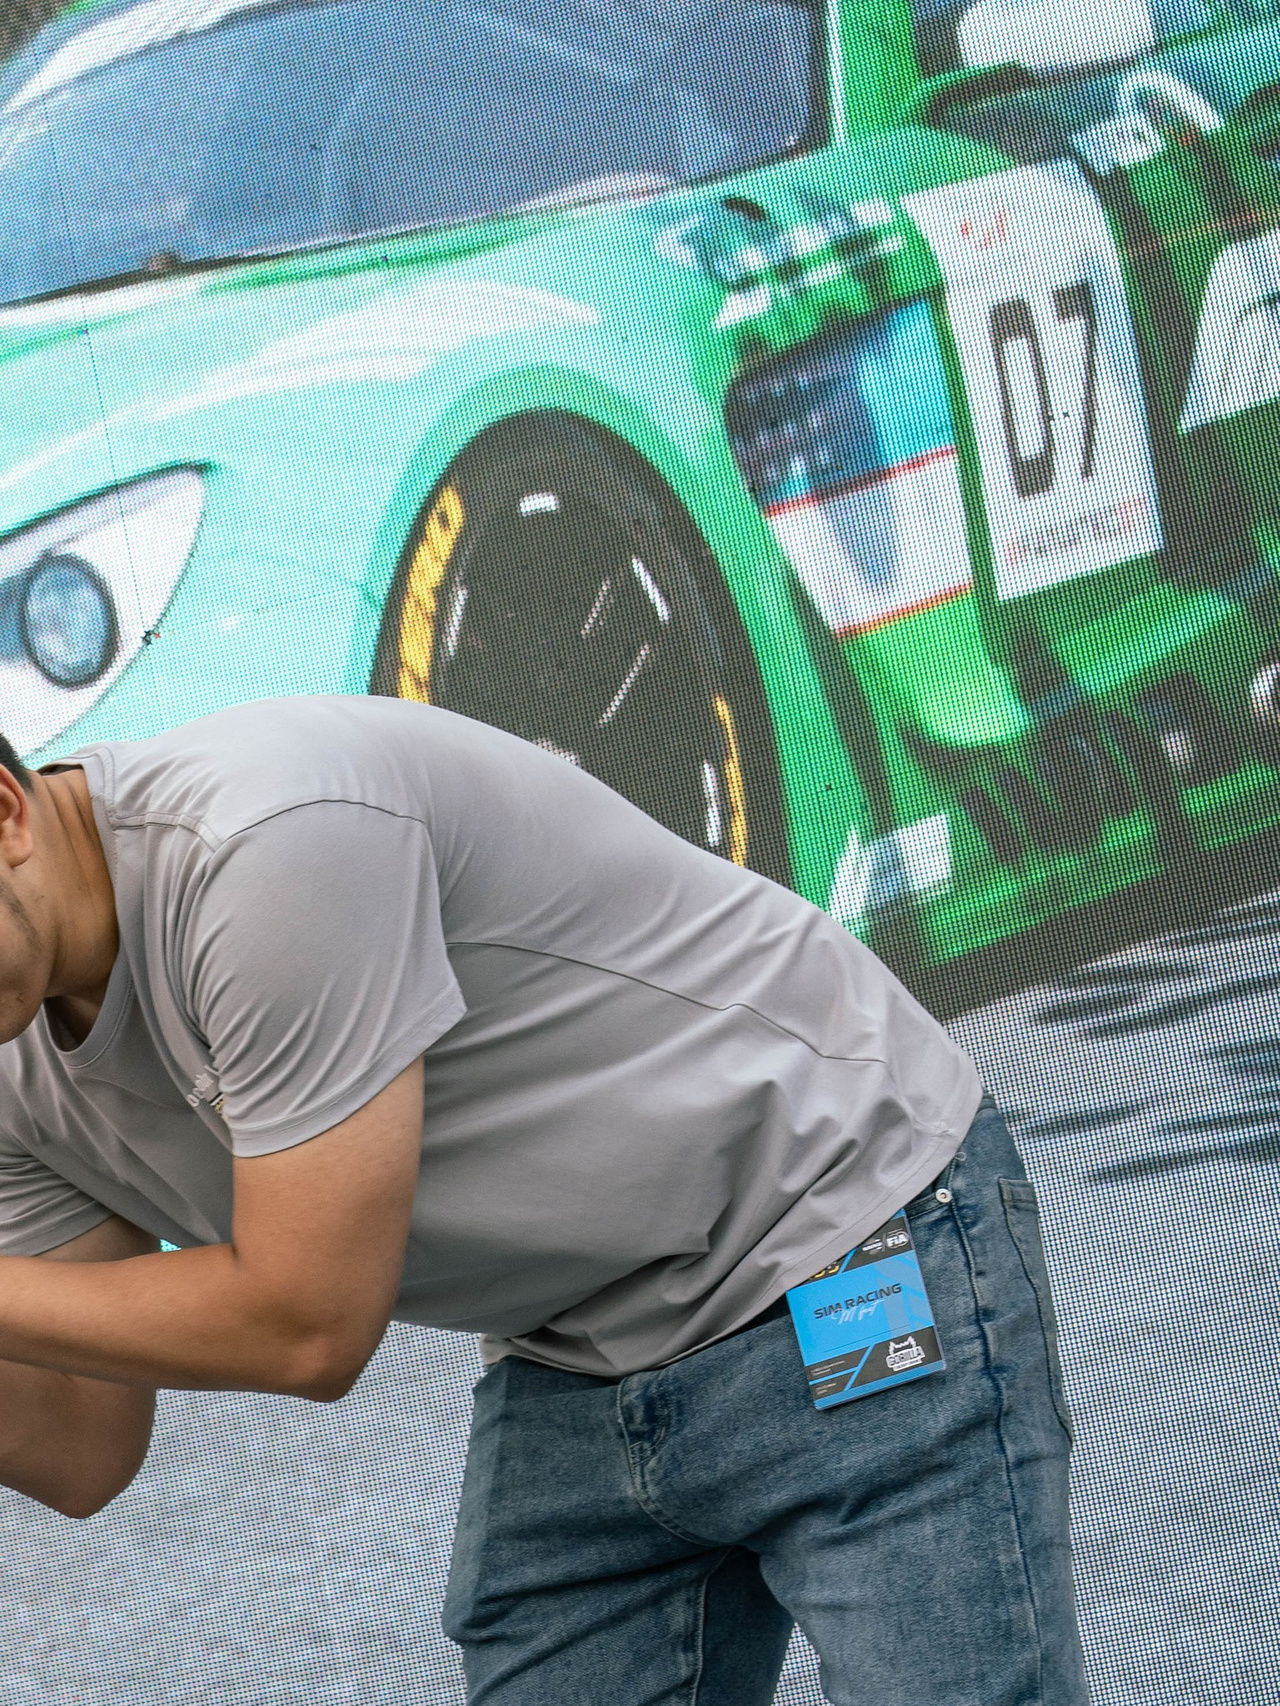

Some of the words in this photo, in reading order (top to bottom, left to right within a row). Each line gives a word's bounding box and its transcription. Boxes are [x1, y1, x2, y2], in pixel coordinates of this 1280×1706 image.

[988, 281, 1096, 498] 07
[814, 1302, 842, 1319] SIM
[845, 1283, 903, 1309] RACING
[888, 1348, 922, 1366] GORILLA
